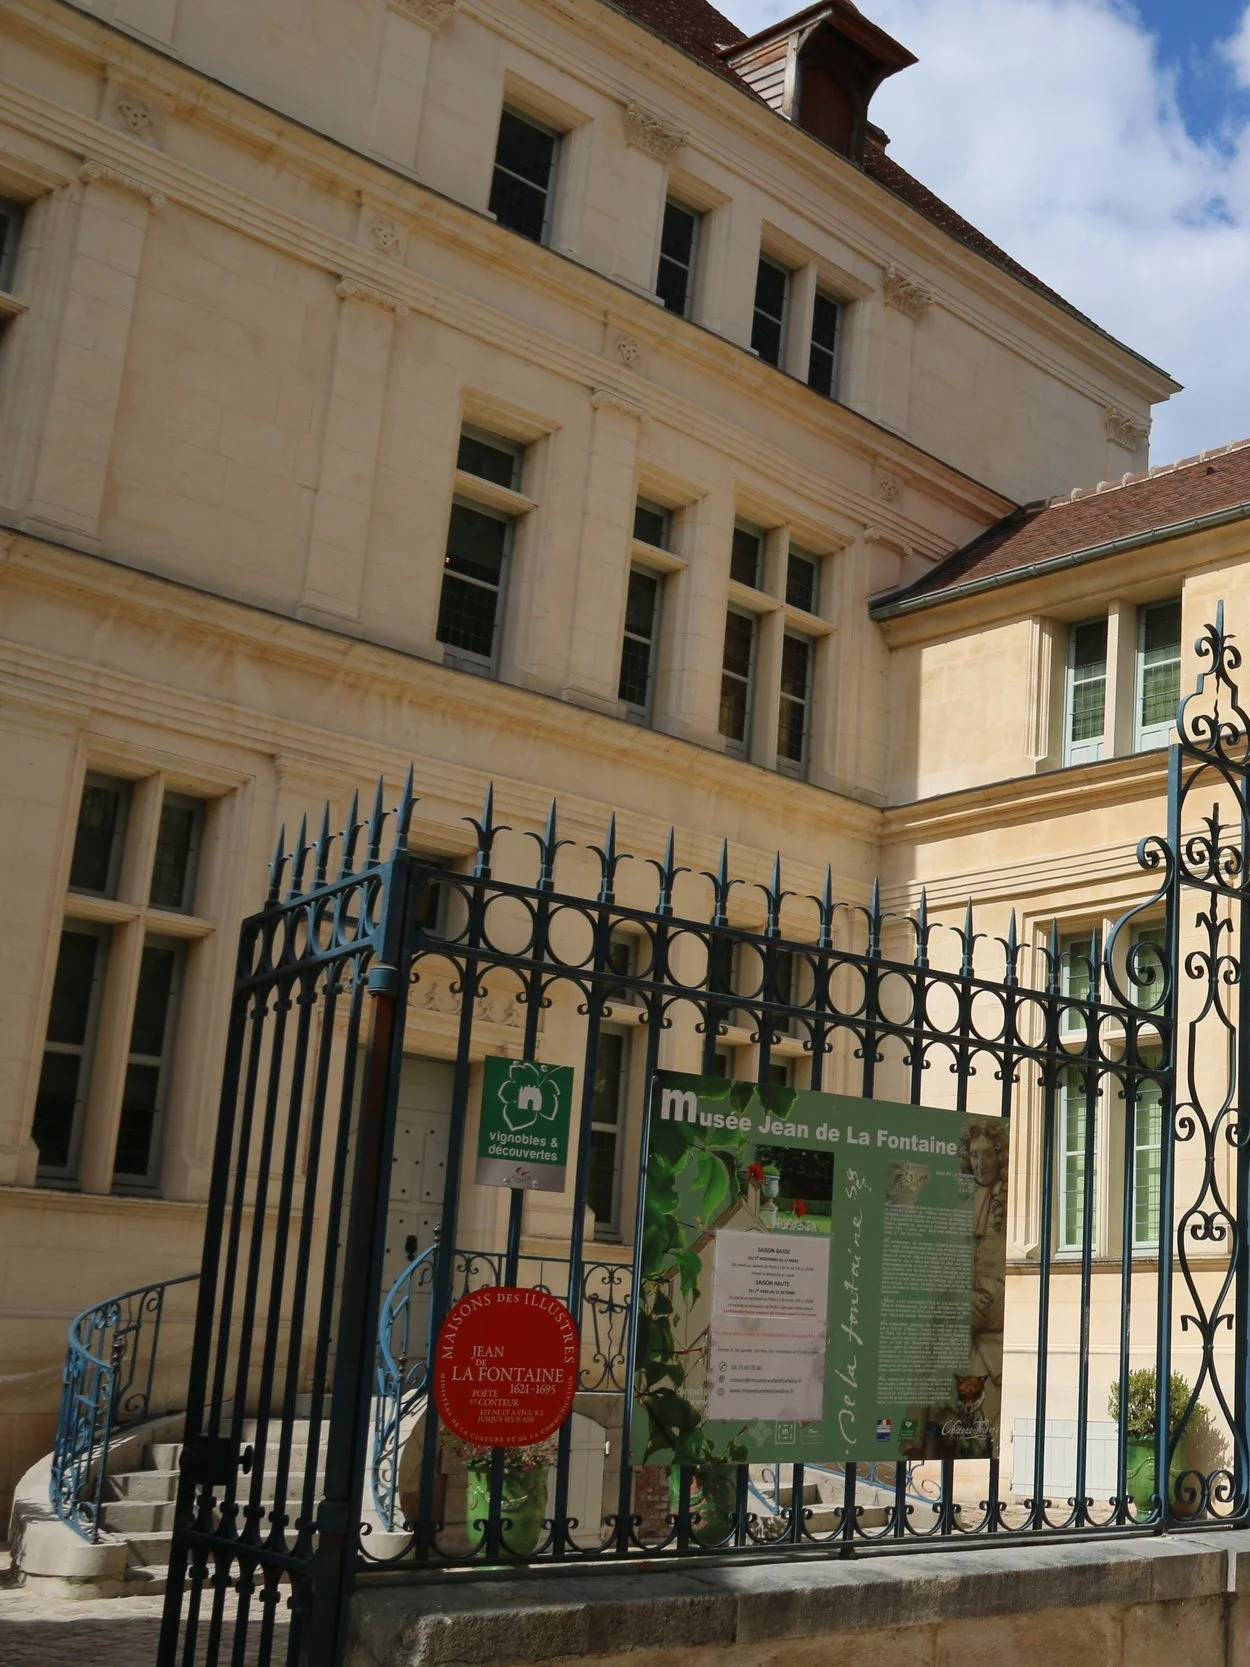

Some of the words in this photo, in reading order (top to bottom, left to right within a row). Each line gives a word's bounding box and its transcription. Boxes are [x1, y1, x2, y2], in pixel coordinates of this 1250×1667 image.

[489, 1131, 547, 1147] vignobles
[550, 1137, 559, 1148] &
[758, 1116, 809, 1139] Jean
[816, 1122, 841, 1142] de
[846, 1126, 870, 1146] La
[877, 1130, 958, 1155] Fontaine
[488, 1144, 558, 1161] découvertes
[442, 1293, 492, 1359] MAISONS
[497, 1293, 520, 1303] DES
[525, 1293, 575, 1364] ILLUSTRES
[470, 1345, 504, 1359] JEAN
[451, 1366, 474, 1381] LA
[478, 1366, 564, 1383] FONTAINE
[478, 1398, 519, 1407] CONTEUR
